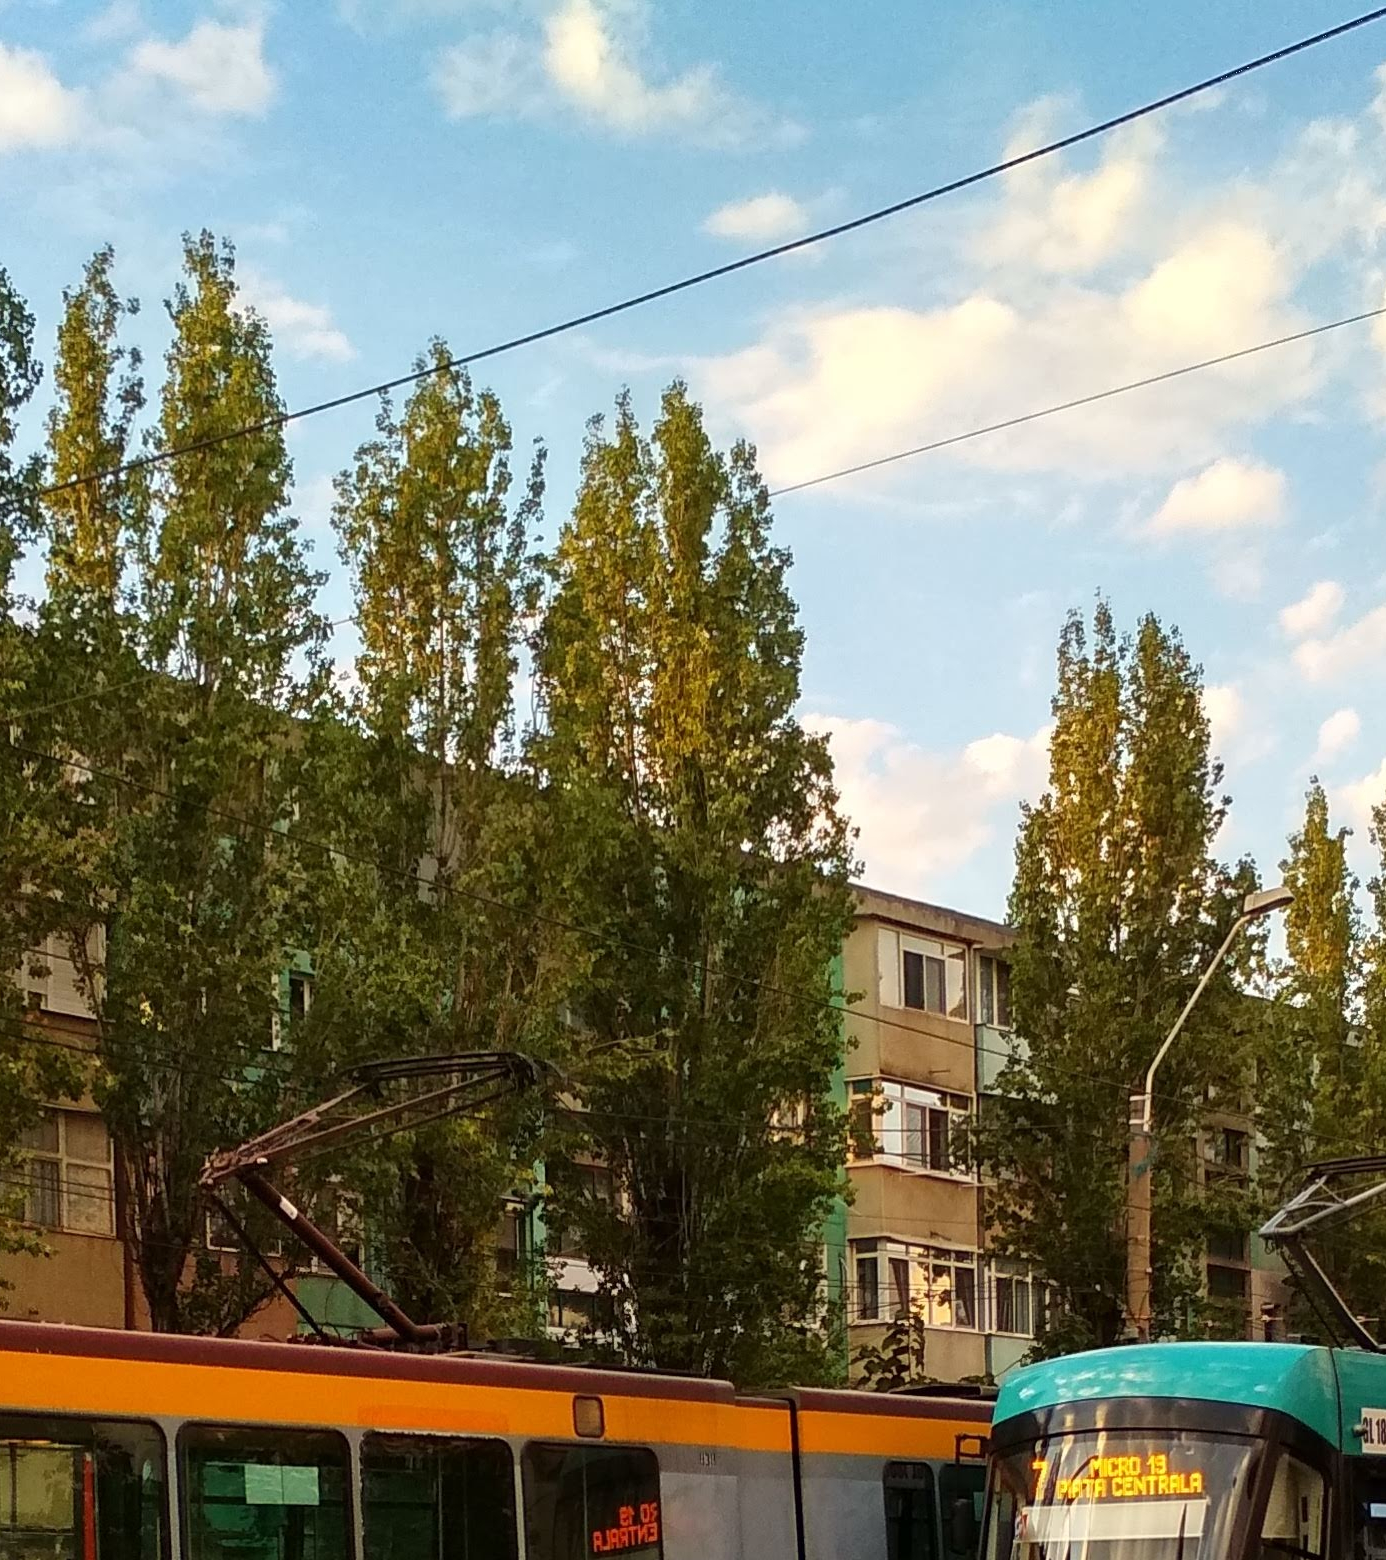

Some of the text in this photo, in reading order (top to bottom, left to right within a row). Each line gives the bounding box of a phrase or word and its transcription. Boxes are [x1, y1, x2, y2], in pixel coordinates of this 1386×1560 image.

[1031, 1460, 1049, 1500] 7
[1089, 1454, 1167, 1478] MICRO 19
[1056, 1472, 1203, 1500] PIATA CENTRALA
